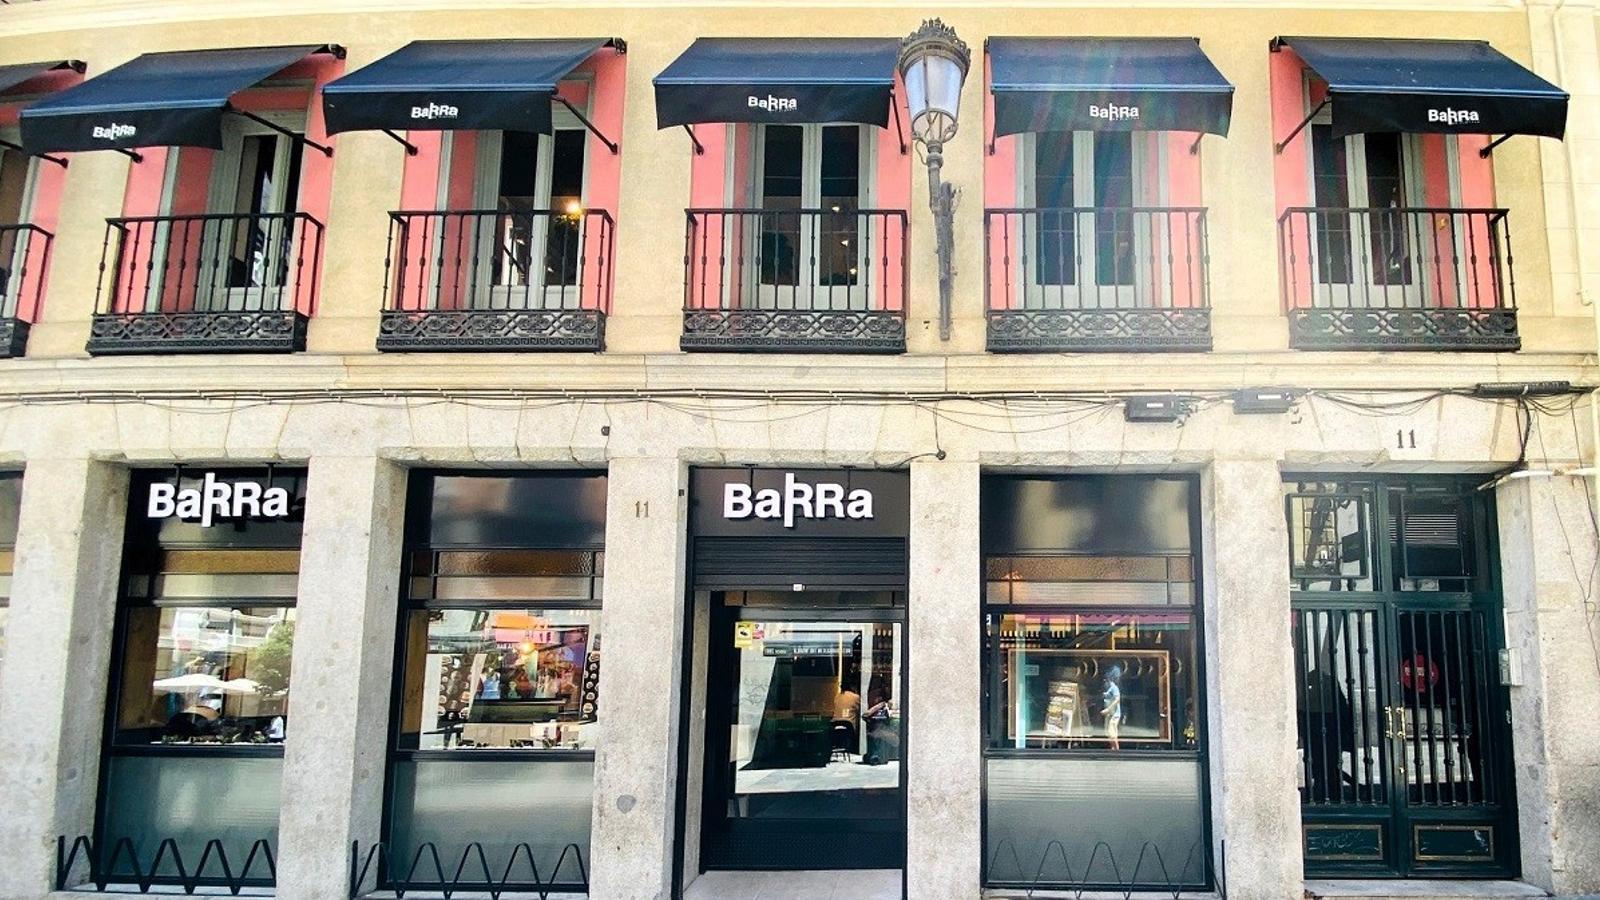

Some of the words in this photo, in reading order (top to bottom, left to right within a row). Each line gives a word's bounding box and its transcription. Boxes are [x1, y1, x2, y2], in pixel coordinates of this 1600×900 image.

[1396, 429, 1417, 449] 11
[147, 472, 289, 528] BaRRa
[635, 500, 650, 518] 11
[723, 472, 874, 528] BaRRa
